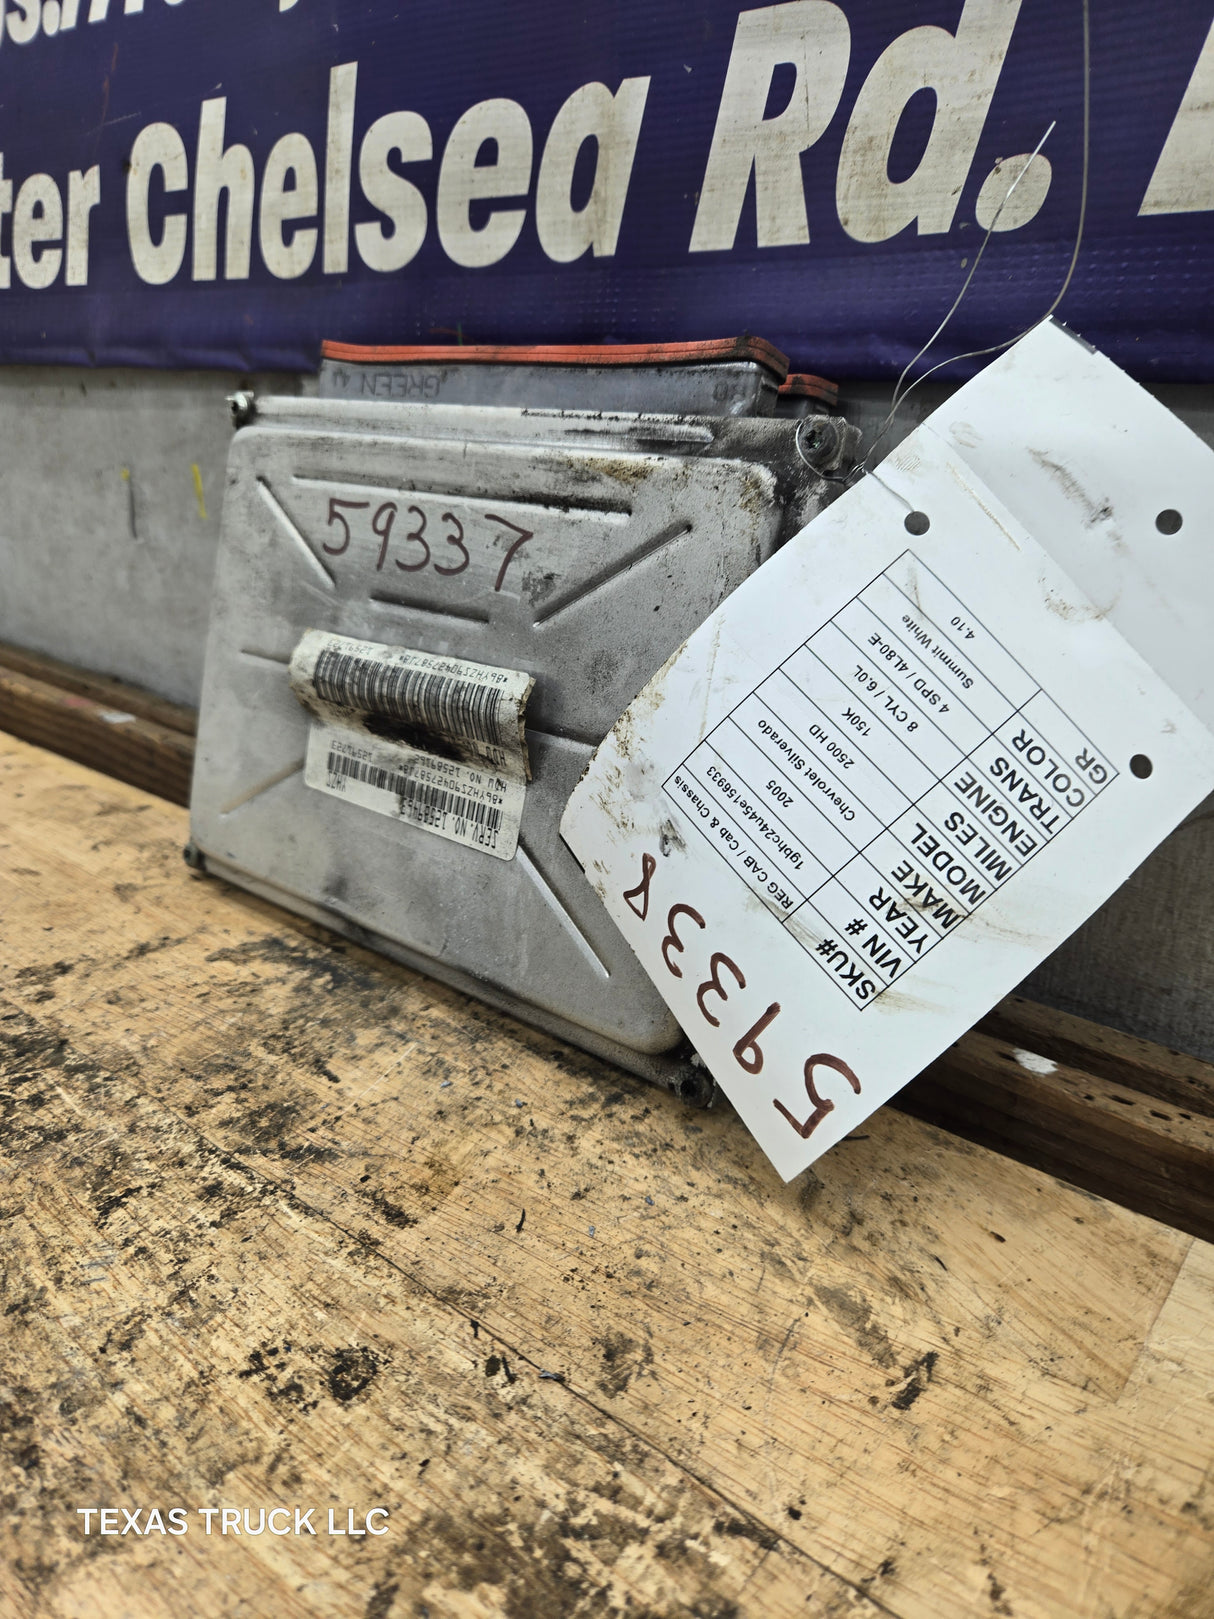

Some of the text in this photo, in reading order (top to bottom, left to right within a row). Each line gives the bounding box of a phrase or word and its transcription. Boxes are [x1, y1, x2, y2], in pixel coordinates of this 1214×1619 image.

[127, 61, 651, 285] Chelsea
[689, 0, 1052, 253] Rd.
[361, 372, 441, 399] GREEN
[323, 498, 533, 592] 59337
[867, 632, 909, 672] 4L80-E
[853, 664, 878, 691] 6.0L
[913, 678, 941, 705] SPD
[884, 695, 908, 722] CYL
[902, 614, 1085, 808] COLOR Summit White
[938, 703, 950, 713] 4
[950, 616, 1108, 785] GR 4.10
[906, 721, 919, 732] 8
[466, 770, 482, 785] NO.
[674, 775, 710, 818] Chassis
[841, 707, 1013, 882] MILES 150K
[989, 757, 1060, 835] TRANS
[452, 816, 467, 836] NO.
[709, 817, 720, 828] &
[758, 719, 961, 930] MAKE Chevrolet Silverado
[808, 724, 987, 905] MODEL 2500 HD
[954, 771, 1037, 857] ENGINE
[470, 824, 499, 849] SERV.
[719, 827, 739, 850] Cab
[706, 766, 902, 978] VIN # 1gbhc24u45e156933
[743, 855, 768, 882] CAB
[765, 780, 929, 954] YEAR 2005
[767, 881, 794, 909] REG
[815, 938, 876, 1000] SKU#
[623, 852, 861, 1139] 59338
